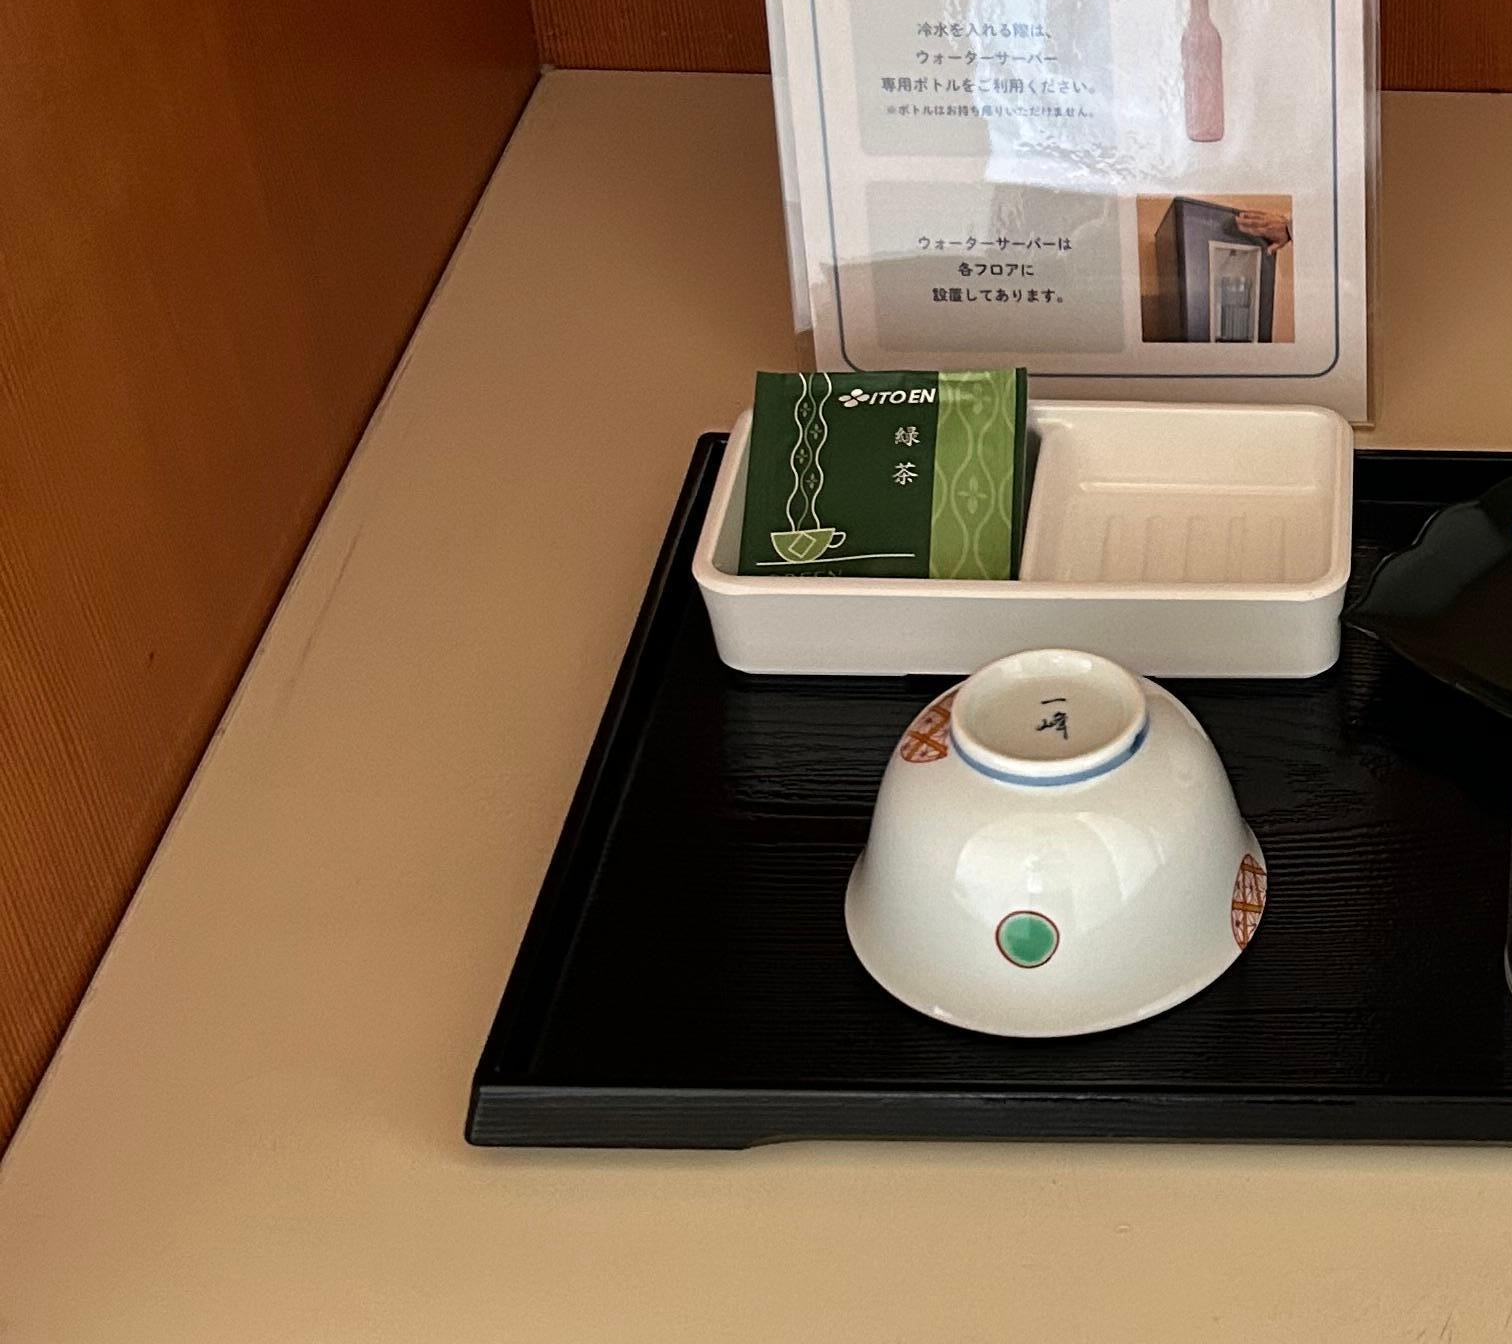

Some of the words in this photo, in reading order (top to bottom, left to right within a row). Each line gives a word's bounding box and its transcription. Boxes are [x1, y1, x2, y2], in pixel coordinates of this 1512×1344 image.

[917, 235, 1073, 251] ウォーターサーバーは
[957, 262, 1035, 277] 各フロアに
[932, 287, 1064, 304] 設置してあります。
[892, 425, 920, 487] 緑茶
